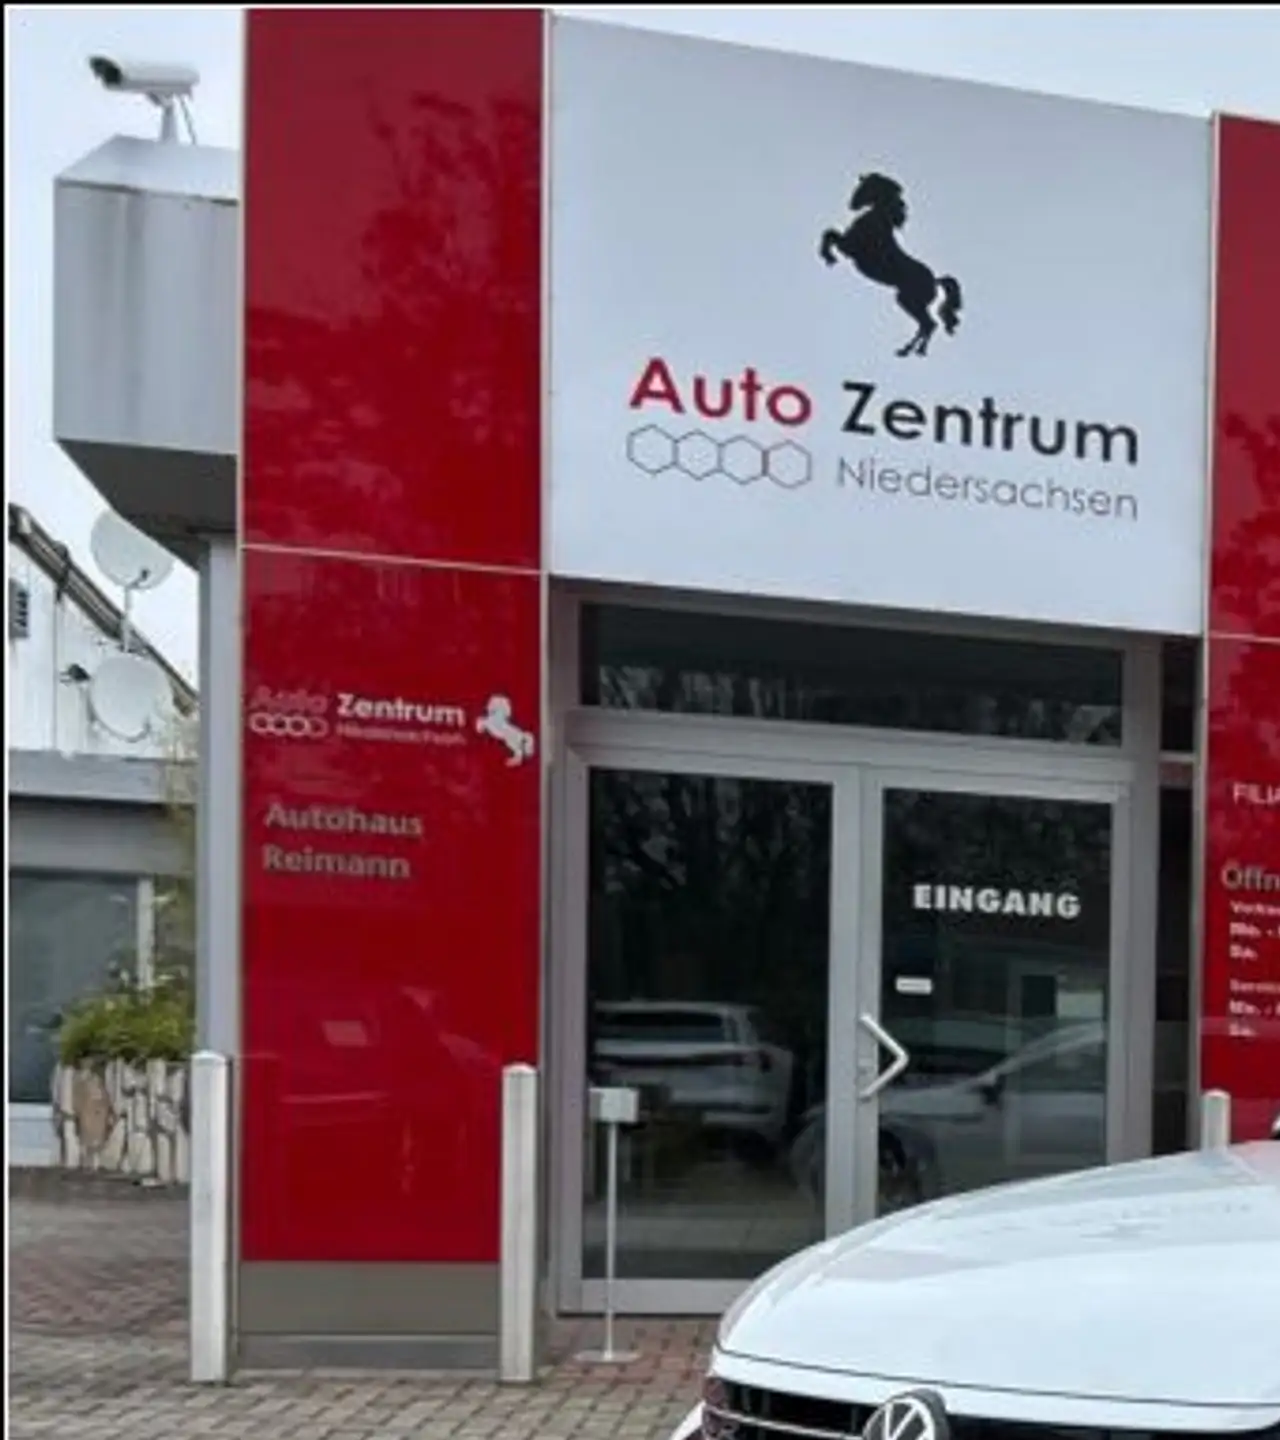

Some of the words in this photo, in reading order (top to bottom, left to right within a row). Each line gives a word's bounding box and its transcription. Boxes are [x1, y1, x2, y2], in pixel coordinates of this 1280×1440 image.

[629, 357, 813, 426] Auto
[841, 381, 1139, 465] Zentrum
[836, 456, 1138, 522] Niedersachsen
[336, 693, 466, 726] Zentrum
[265, 802, 424, 837] Autohaus
[263, 844, 411, 879] Reimann
[913, 884, 1081, 919] EINGANG
